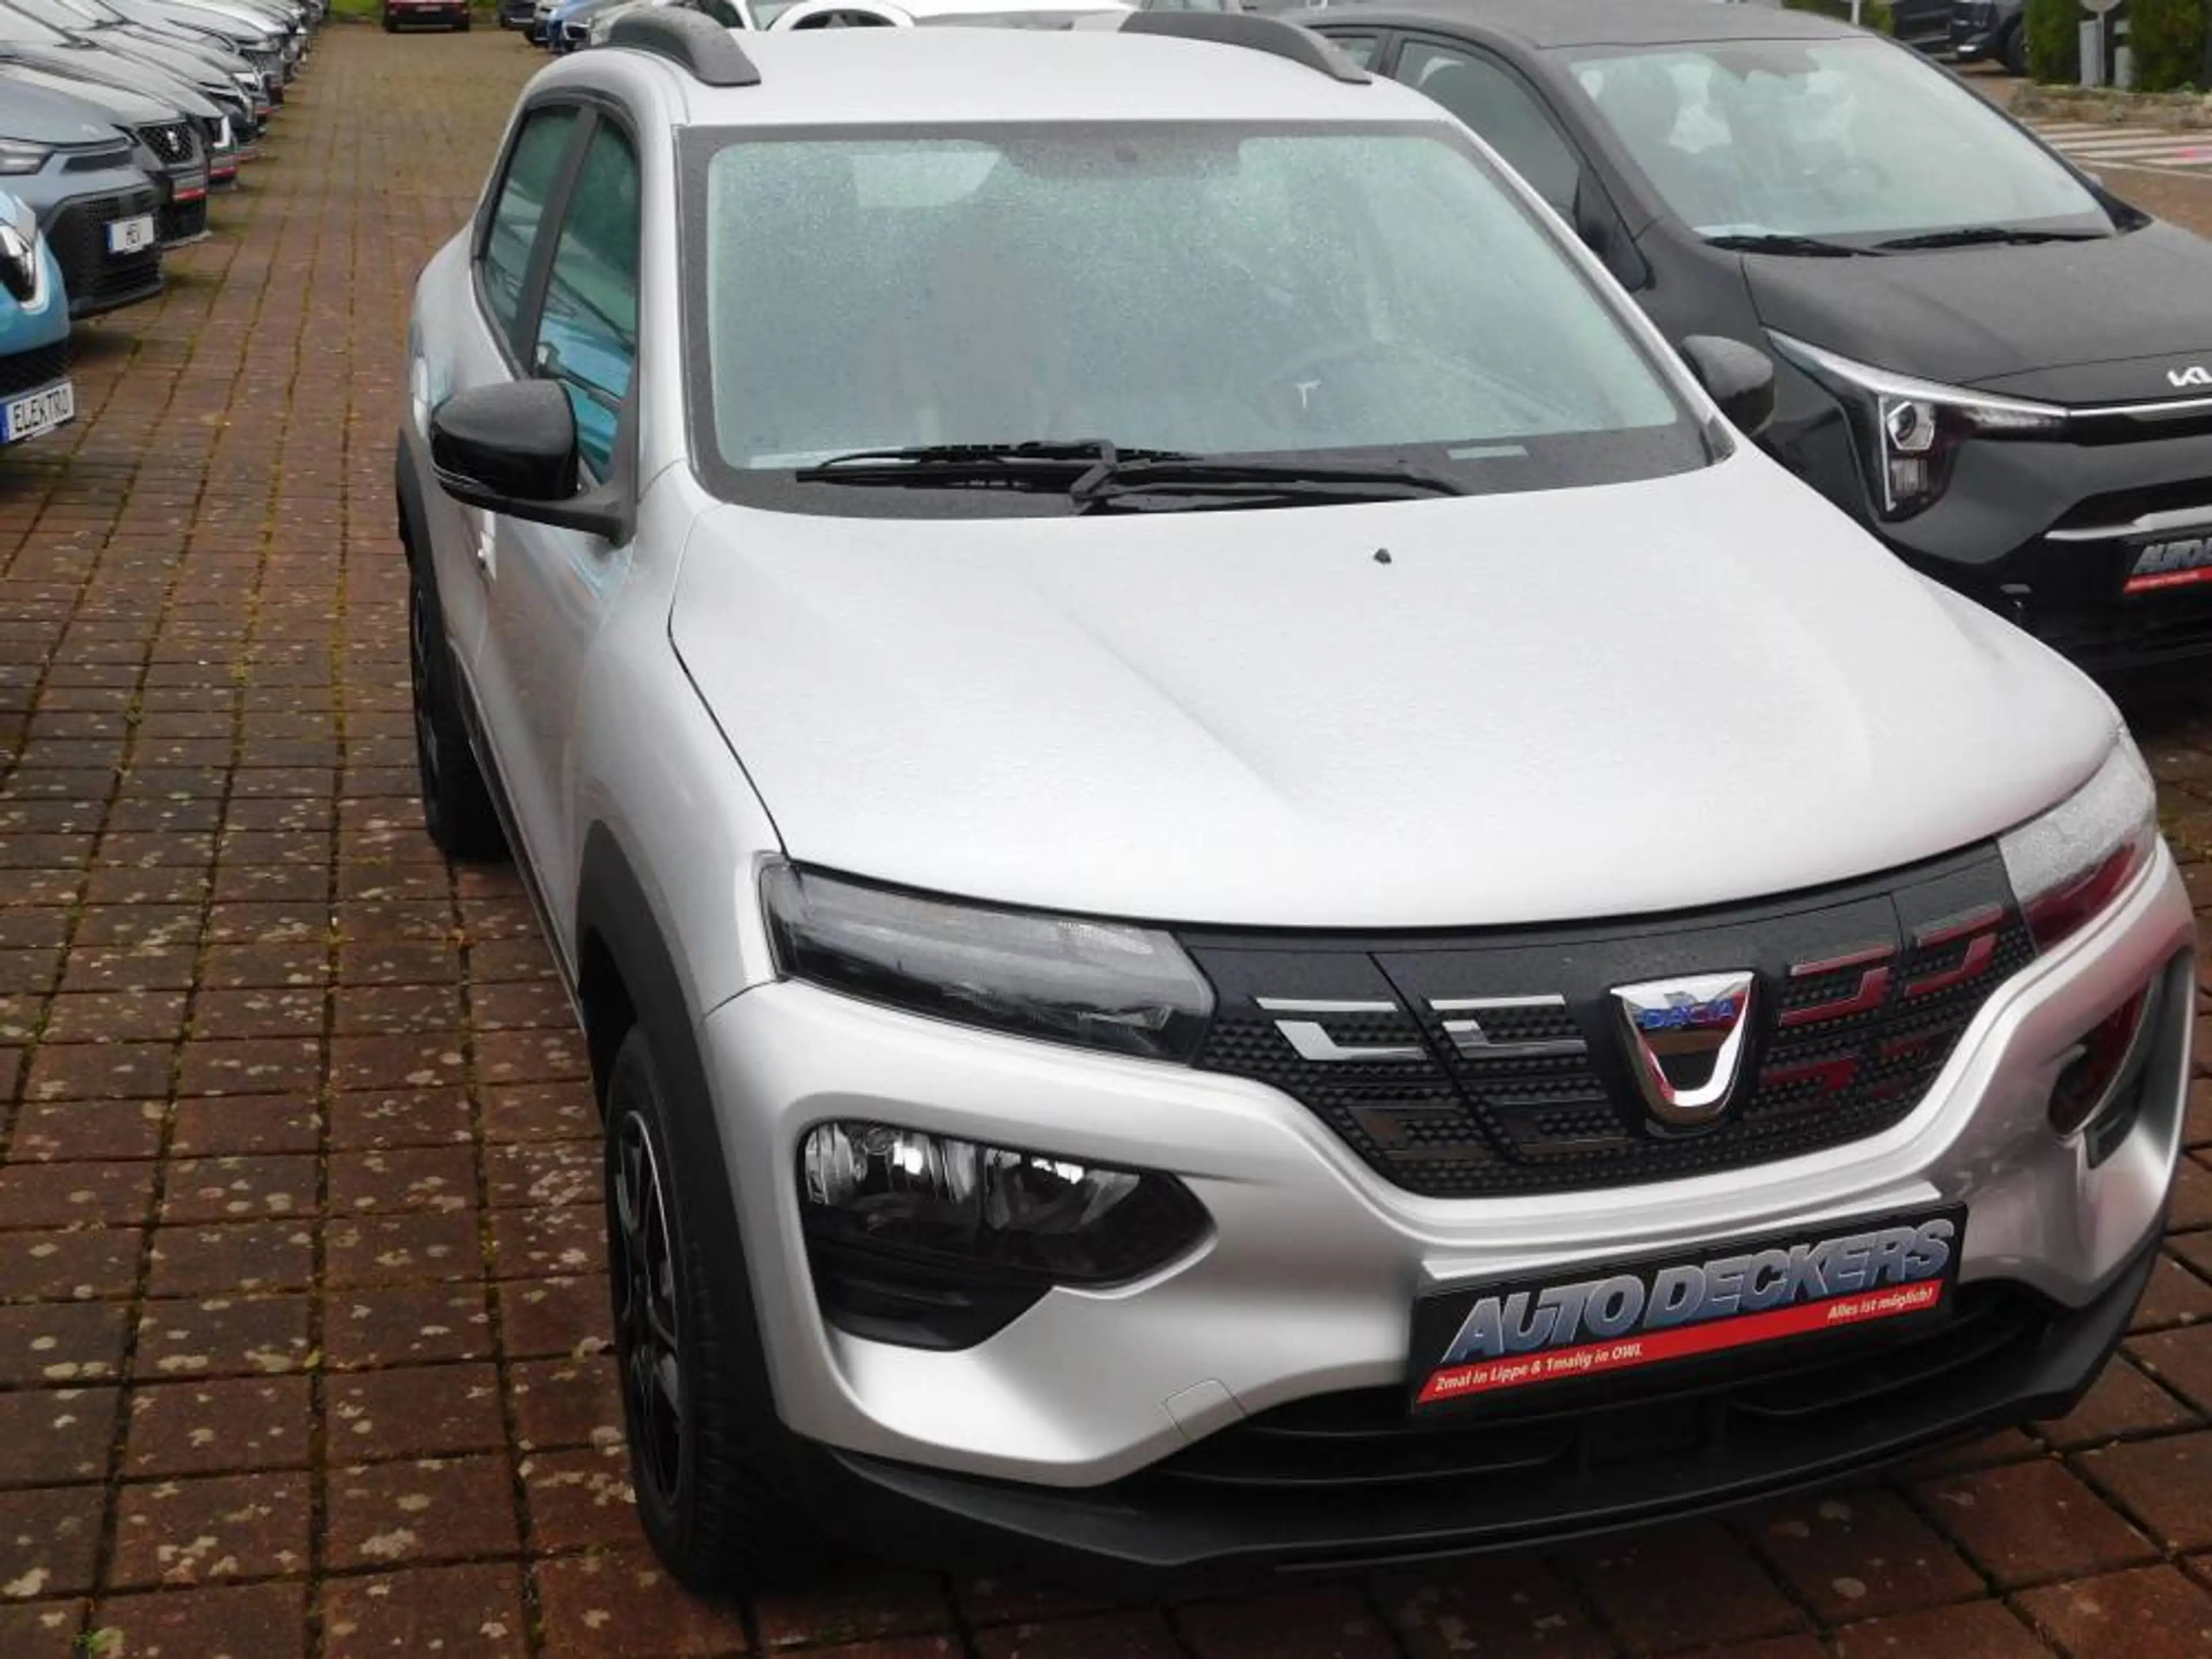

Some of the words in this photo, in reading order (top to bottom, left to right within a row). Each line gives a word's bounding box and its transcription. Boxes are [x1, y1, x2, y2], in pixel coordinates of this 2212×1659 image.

[1440, 1274, 1645, 1363] AUTO
[1645, 1218, 1955, 1327] DECKERS
[1827, 1302, 1858, 1320] Alles
[1859, 1298, 1878, 1314] ist
[1435, 1370, 1472, 1392] 2mal
[1472, 1370, 1488, 1385] in
[1490, 1365, 1529, 1384] Lippe
[1531, 1359, 1541, 1376] &
[1594, 1349, 1609, 1363] in
[1612, 1343, 1643, 1361] OWL
